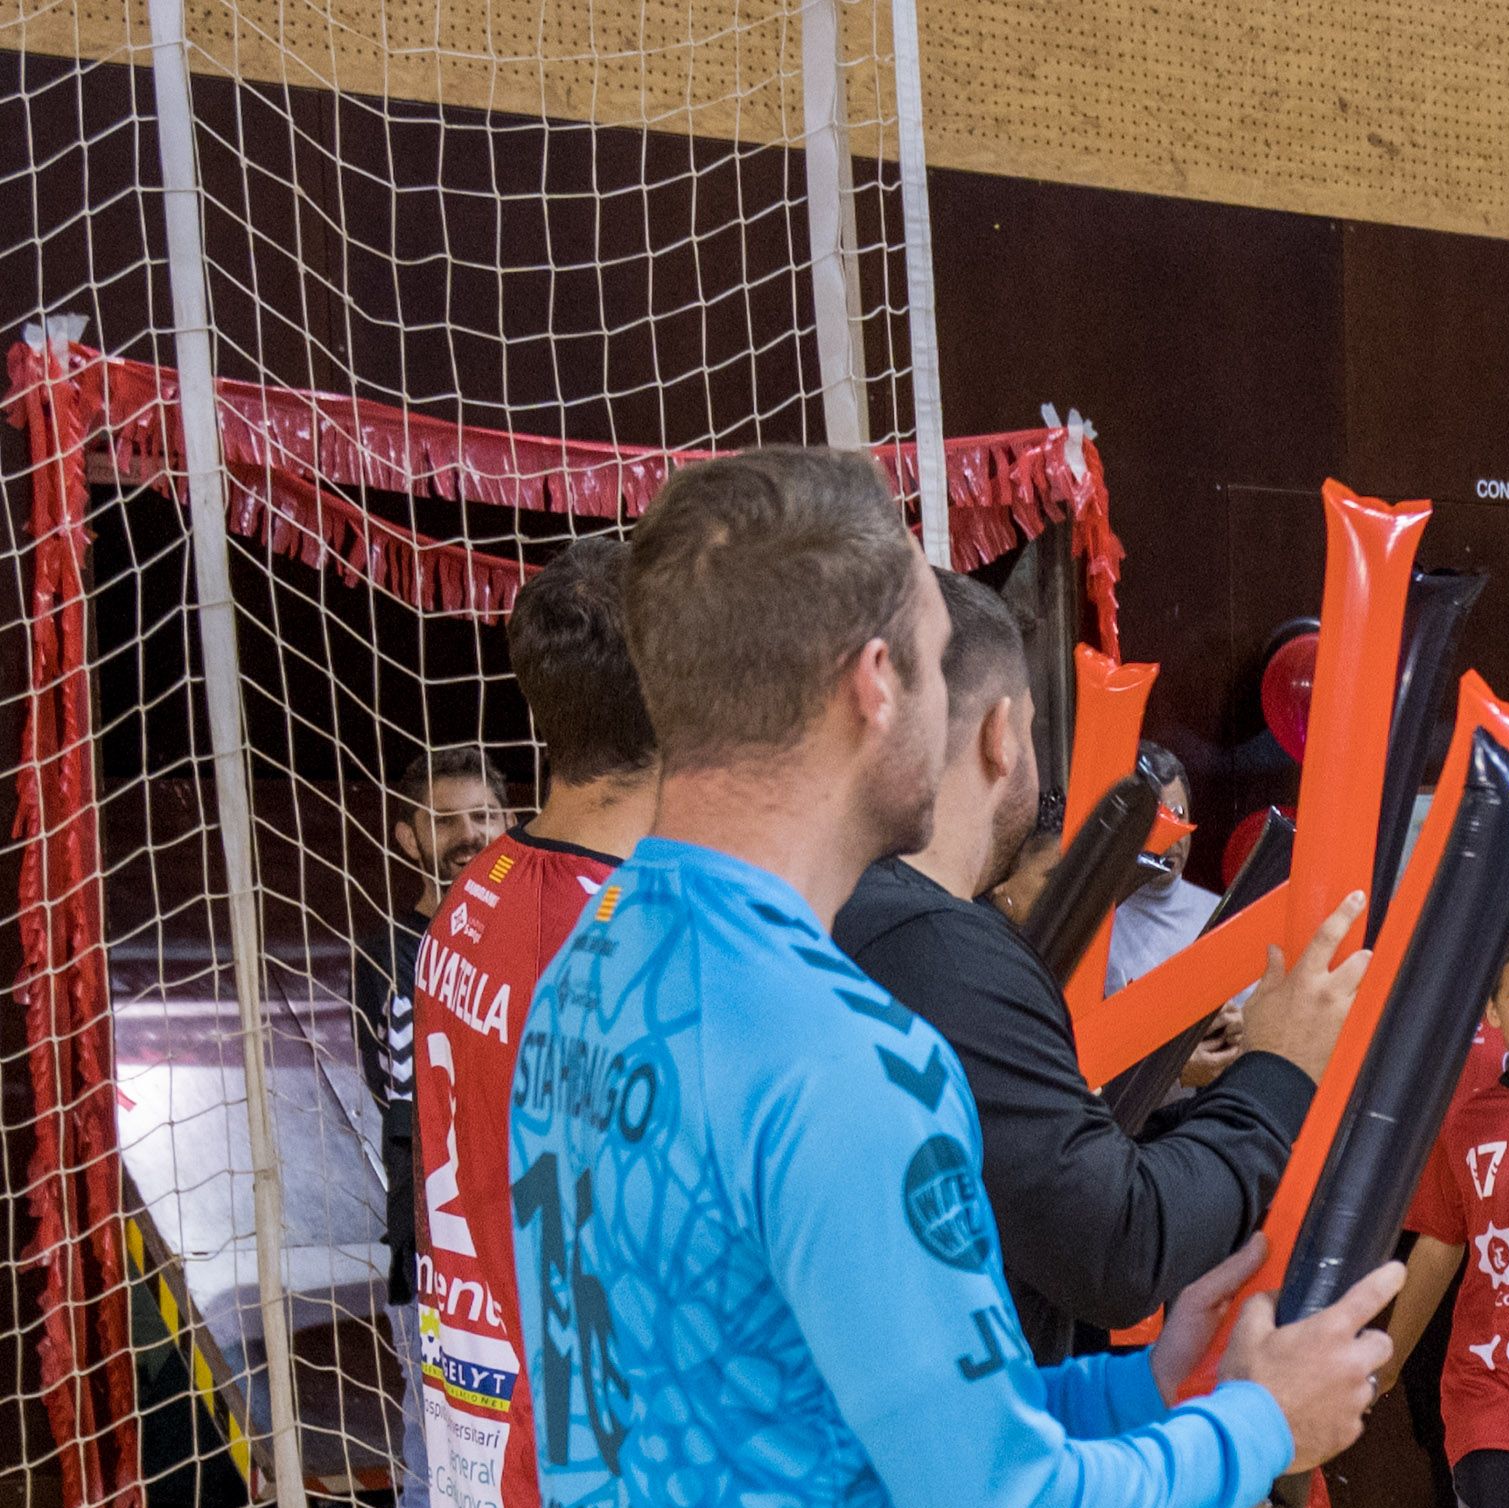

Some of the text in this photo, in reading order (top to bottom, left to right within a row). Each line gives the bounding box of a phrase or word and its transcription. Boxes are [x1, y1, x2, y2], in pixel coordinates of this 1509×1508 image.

[425, 1032, 478, 1259] 2
[1466, 1140, 1508, 1200] 17
[440, 1357, 506, 1394] GELYT
